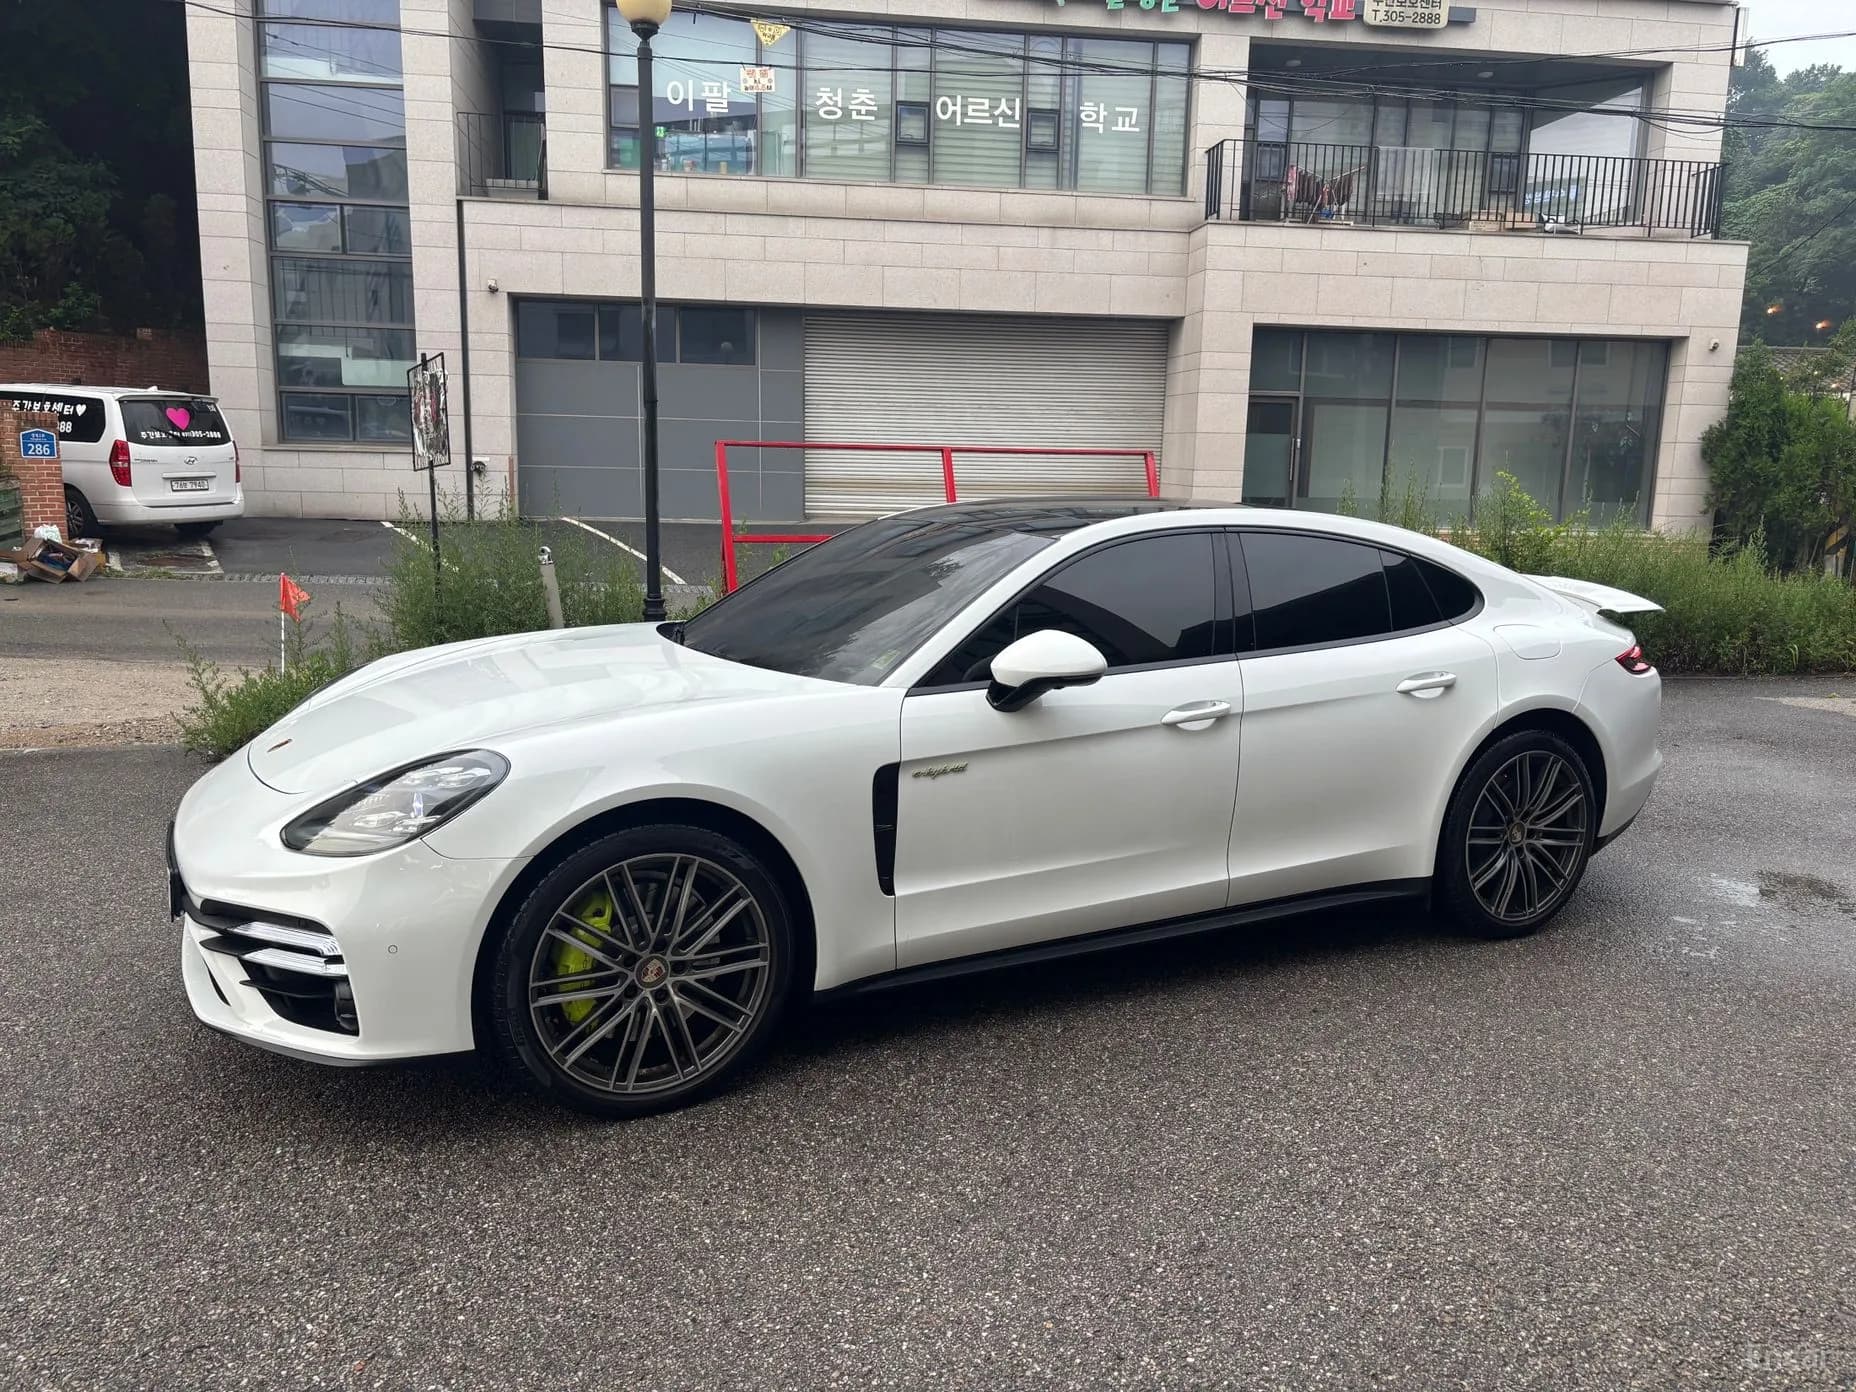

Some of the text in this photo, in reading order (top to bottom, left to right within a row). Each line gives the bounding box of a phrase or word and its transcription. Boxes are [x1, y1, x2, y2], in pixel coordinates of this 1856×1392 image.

[1372, 9, 1441, 24] T.305-2888
[666, 80, 731, 113] 이팔
[815, 87, 878, 121] 청춘
[936, 95, 1020, 128] 어르신
[1079, 102, 1140, 133] 학교
[27, 443, 50, 455] 286
